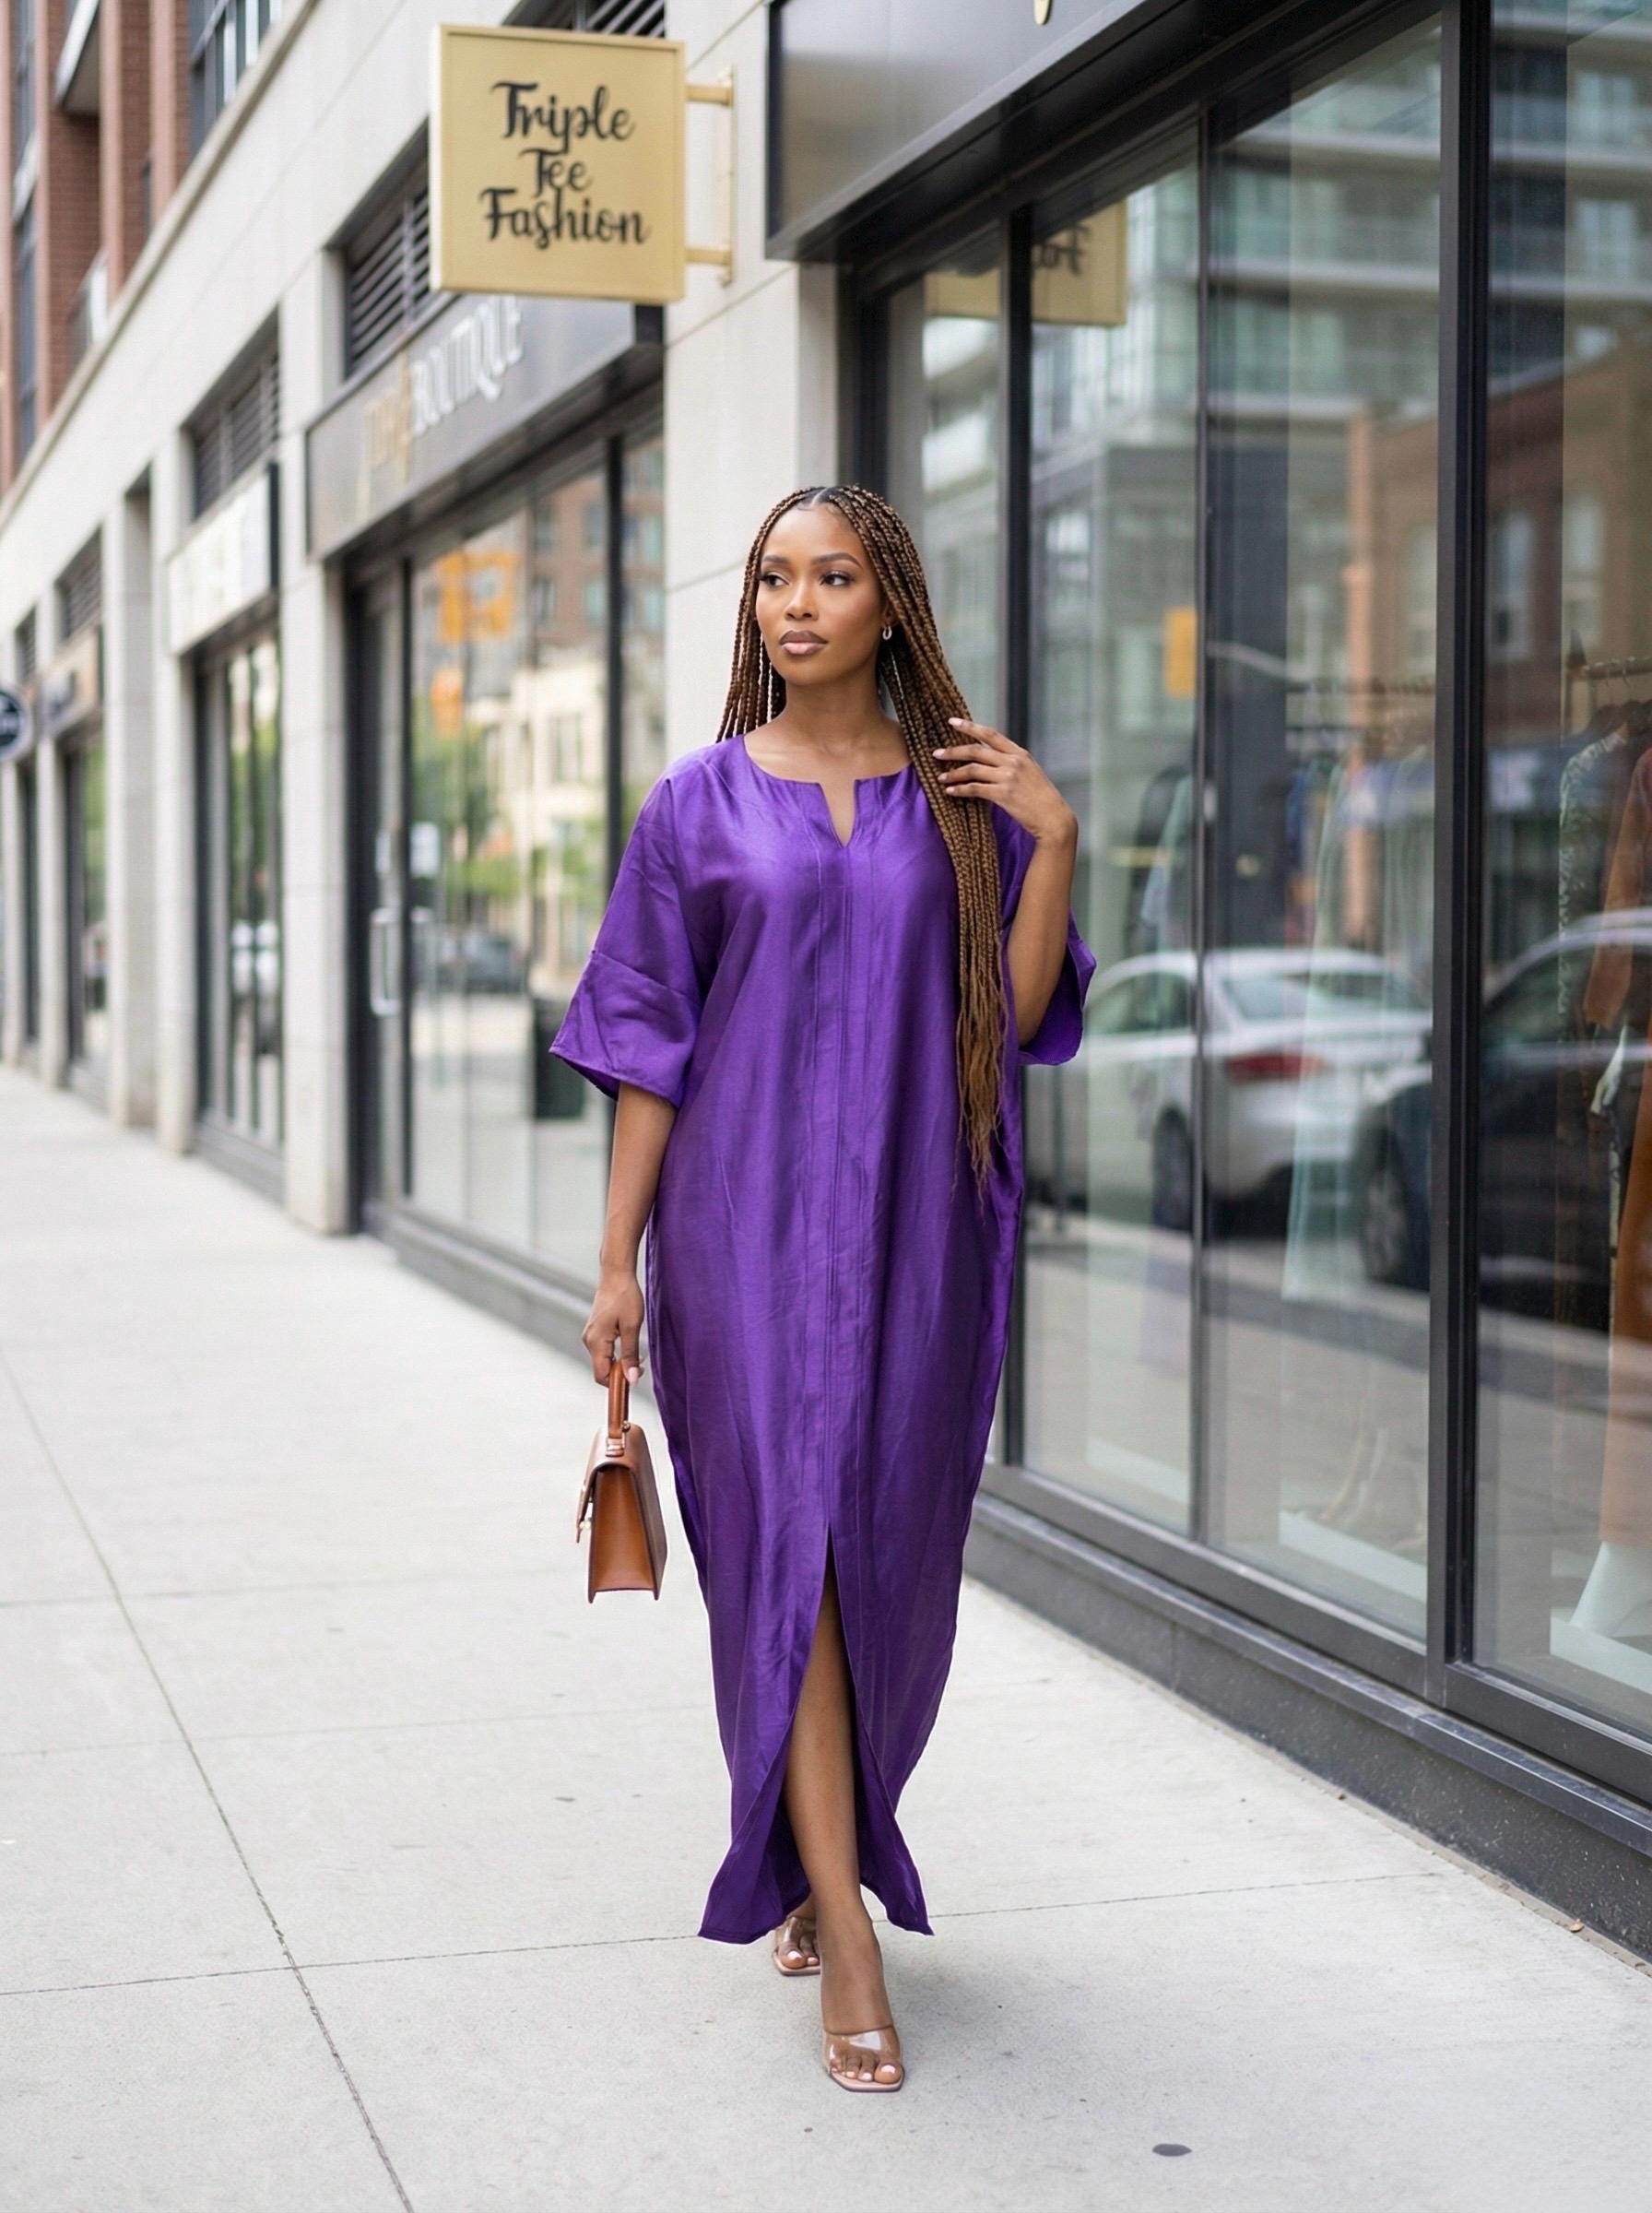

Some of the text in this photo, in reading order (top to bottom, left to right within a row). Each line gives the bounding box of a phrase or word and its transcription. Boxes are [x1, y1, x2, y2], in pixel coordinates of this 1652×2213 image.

[490, 80, 637, 154] Triple
[518, 148, 594, 198] Tee
[478, 186, 653, 250] Fashion
